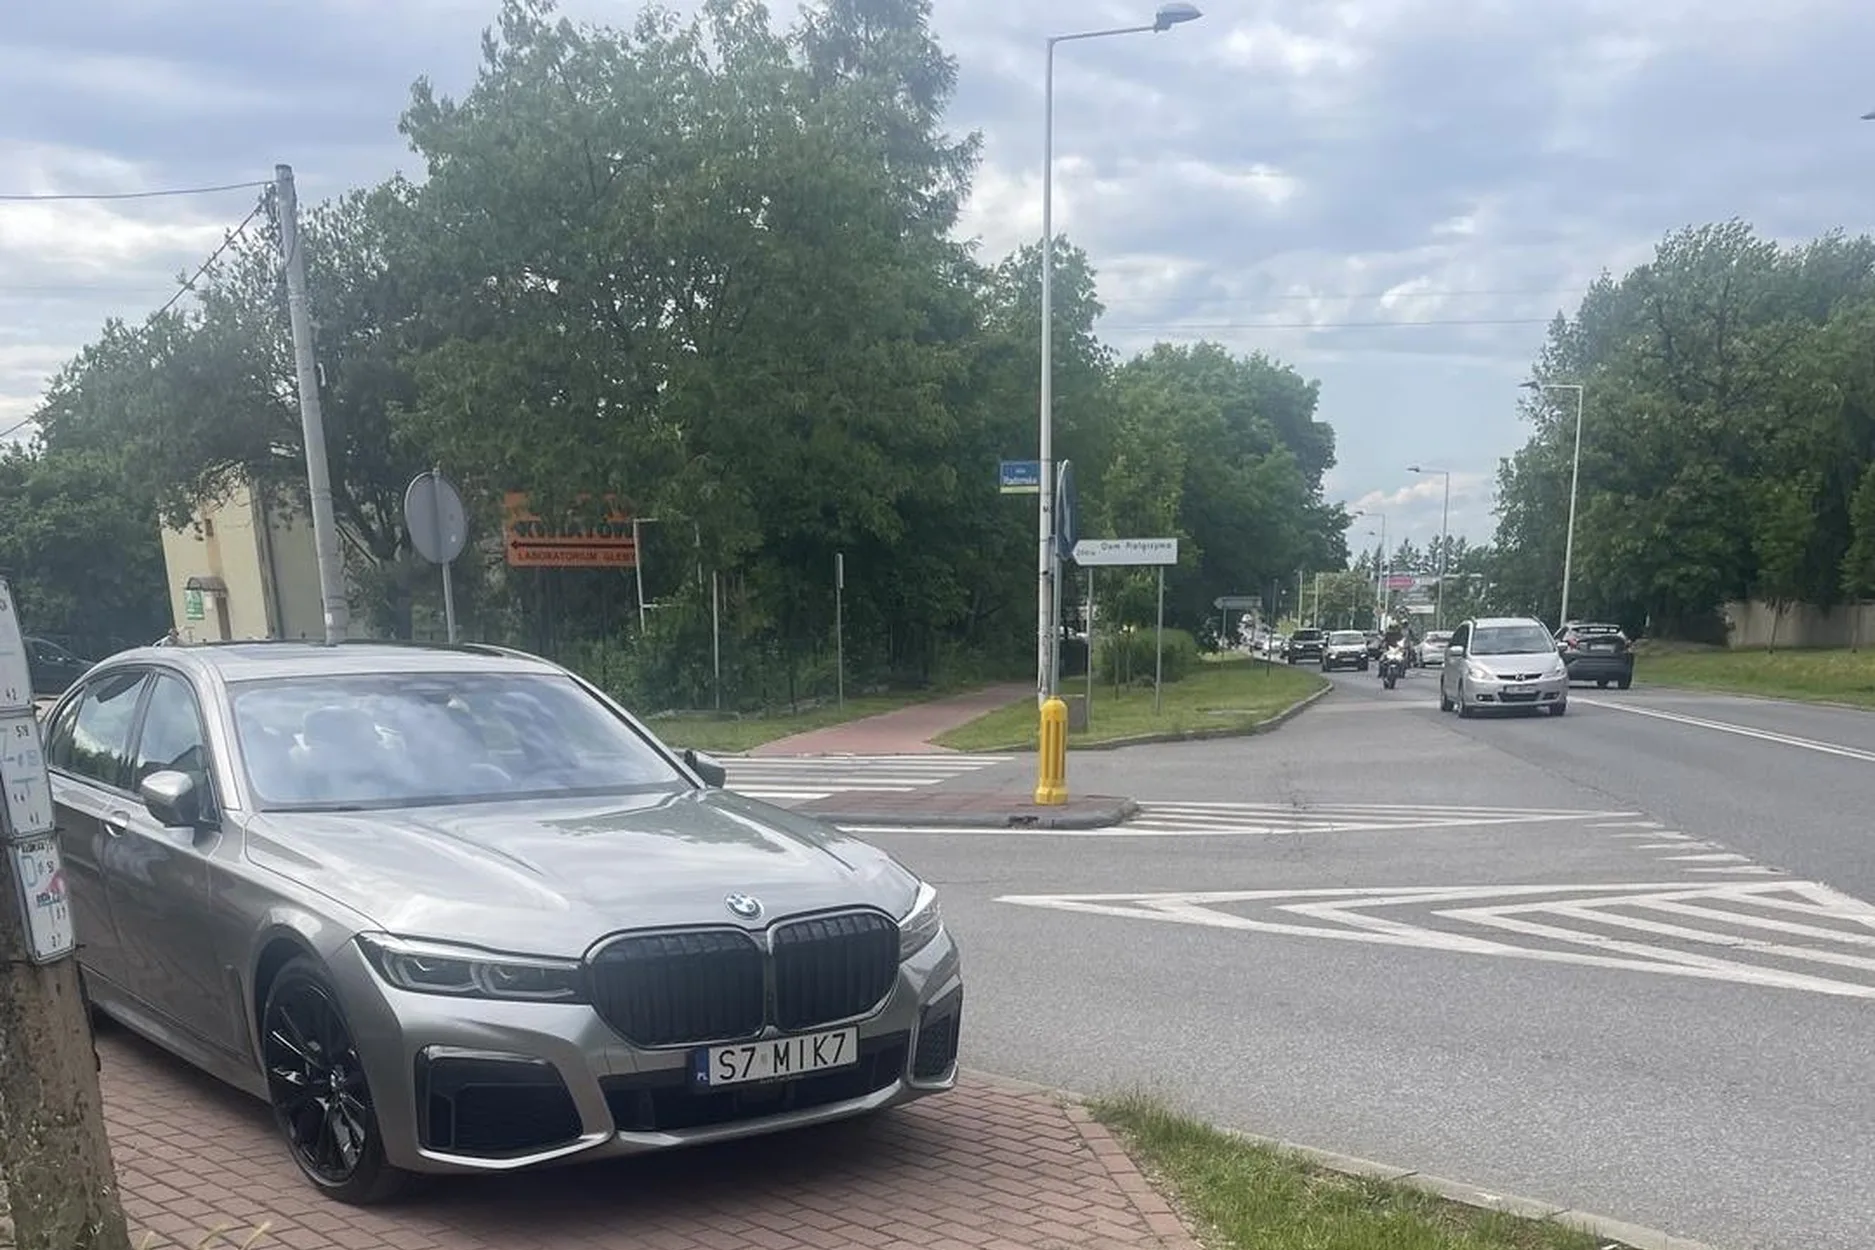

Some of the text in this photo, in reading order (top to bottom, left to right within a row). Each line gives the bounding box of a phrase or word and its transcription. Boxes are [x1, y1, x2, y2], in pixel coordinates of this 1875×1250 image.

[1100, 542, 1120, 551] Dom
[518, 551, 598, 561] LABORATORIUM
[719, 1032, 846, 1080] S7 MIK7
